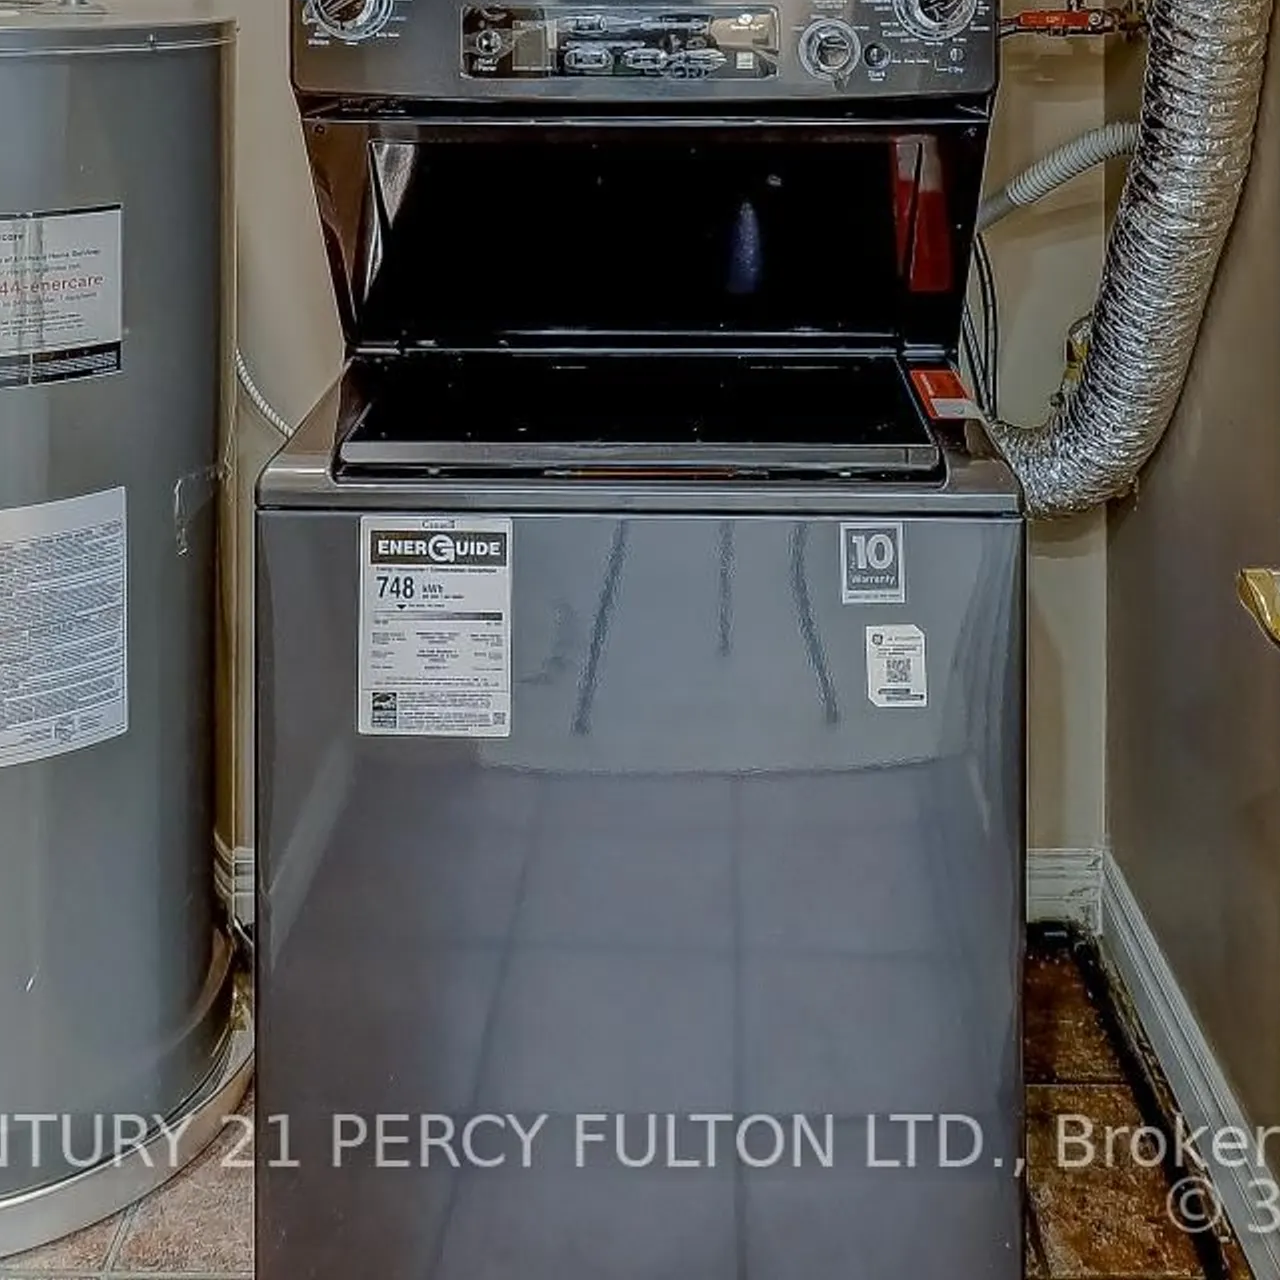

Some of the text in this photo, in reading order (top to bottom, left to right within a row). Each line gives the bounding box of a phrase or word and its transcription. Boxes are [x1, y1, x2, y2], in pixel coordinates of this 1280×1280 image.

[377, 533, 502, 563] ENERGUIDE
[851, 534, 895, 570] 10
[376, 576, 415, 600] 748
[851, 574, 896, 586] Warranty
